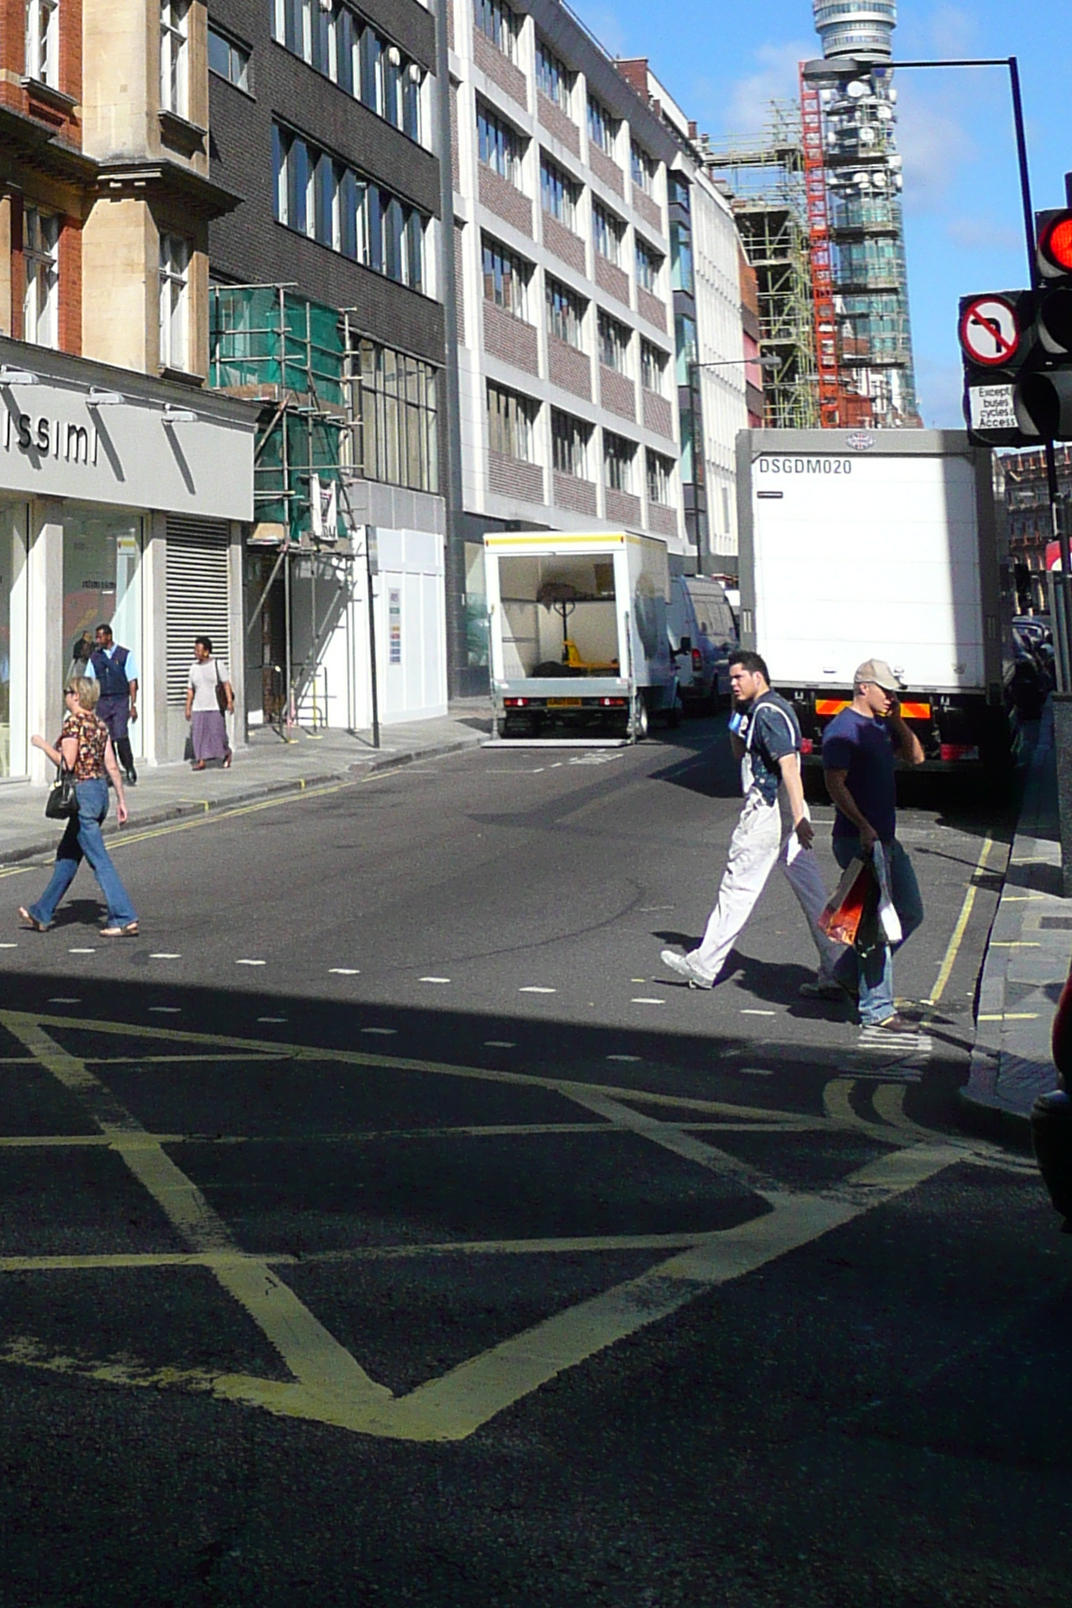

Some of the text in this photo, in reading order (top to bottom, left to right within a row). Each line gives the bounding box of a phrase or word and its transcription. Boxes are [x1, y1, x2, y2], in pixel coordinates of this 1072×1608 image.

[979, 387, 1010, 398] Except
[983, 399, 1009, 408] buses
[980, 408, 1009, 418] cycles
[979, 418, 1016, 427] Access
[759, 458, 852, 474] DSGDM020
